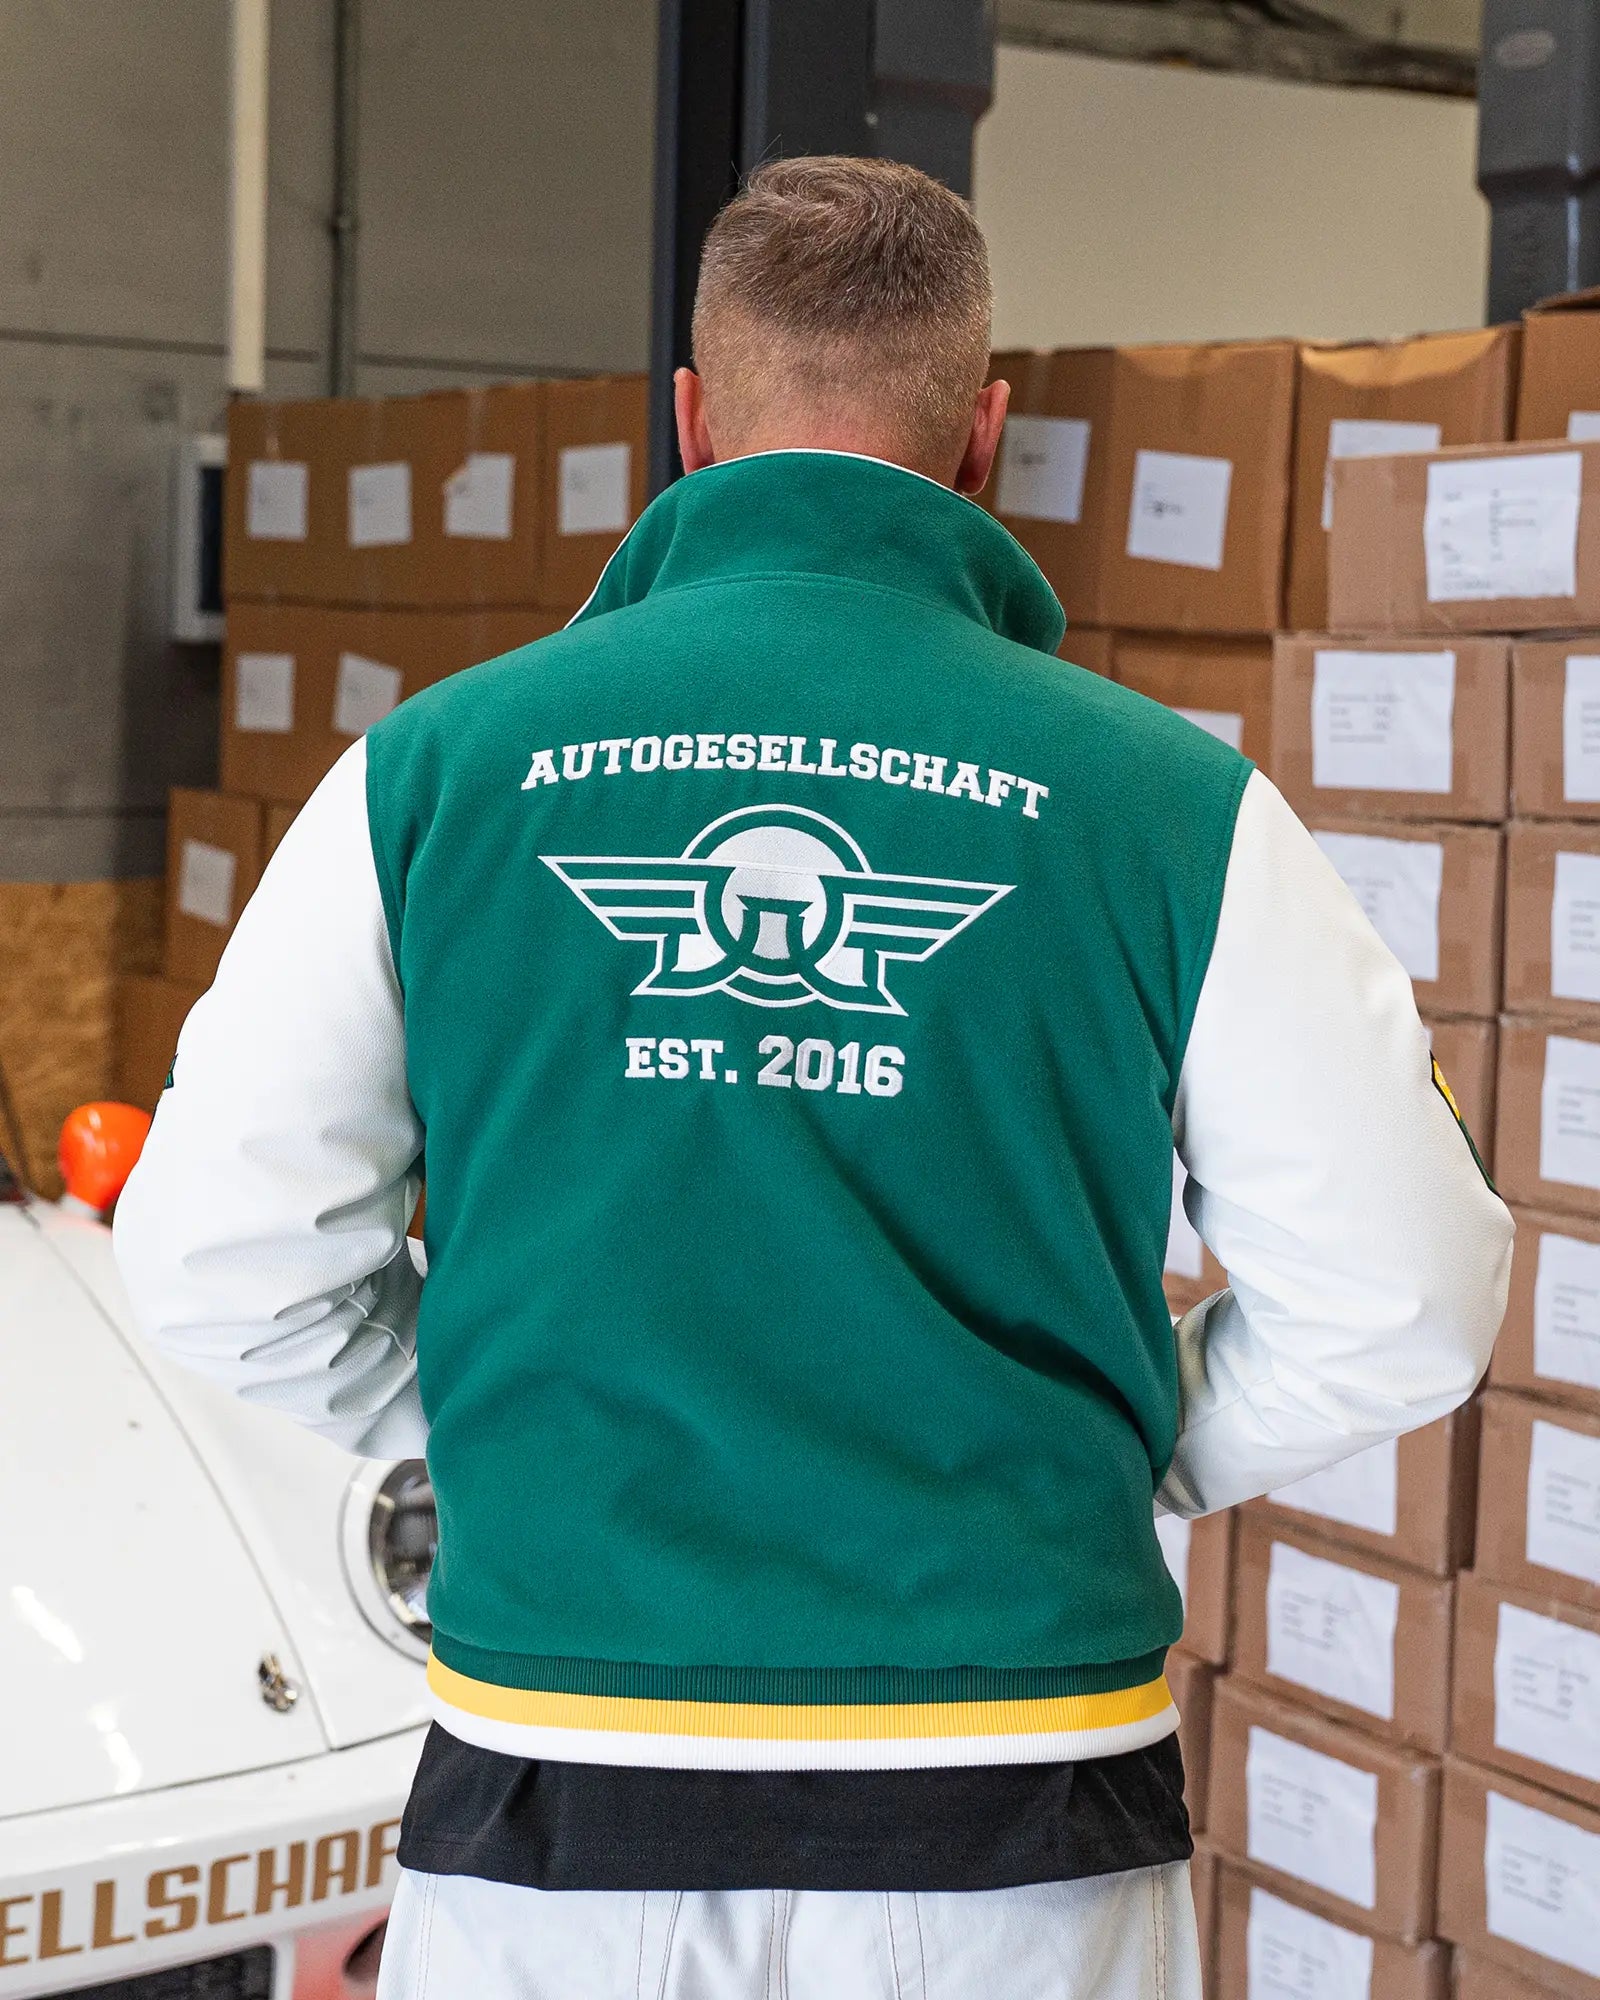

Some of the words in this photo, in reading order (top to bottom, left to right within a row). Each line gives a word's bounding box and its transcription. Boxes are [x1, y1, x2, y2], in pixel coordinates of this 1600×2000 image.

[520, 733, 1050, 819] AUTOGESELLSCHAFT
[624, 1038, 738, 1084] EST.
[757, 1035, 905, 1097] 2016
